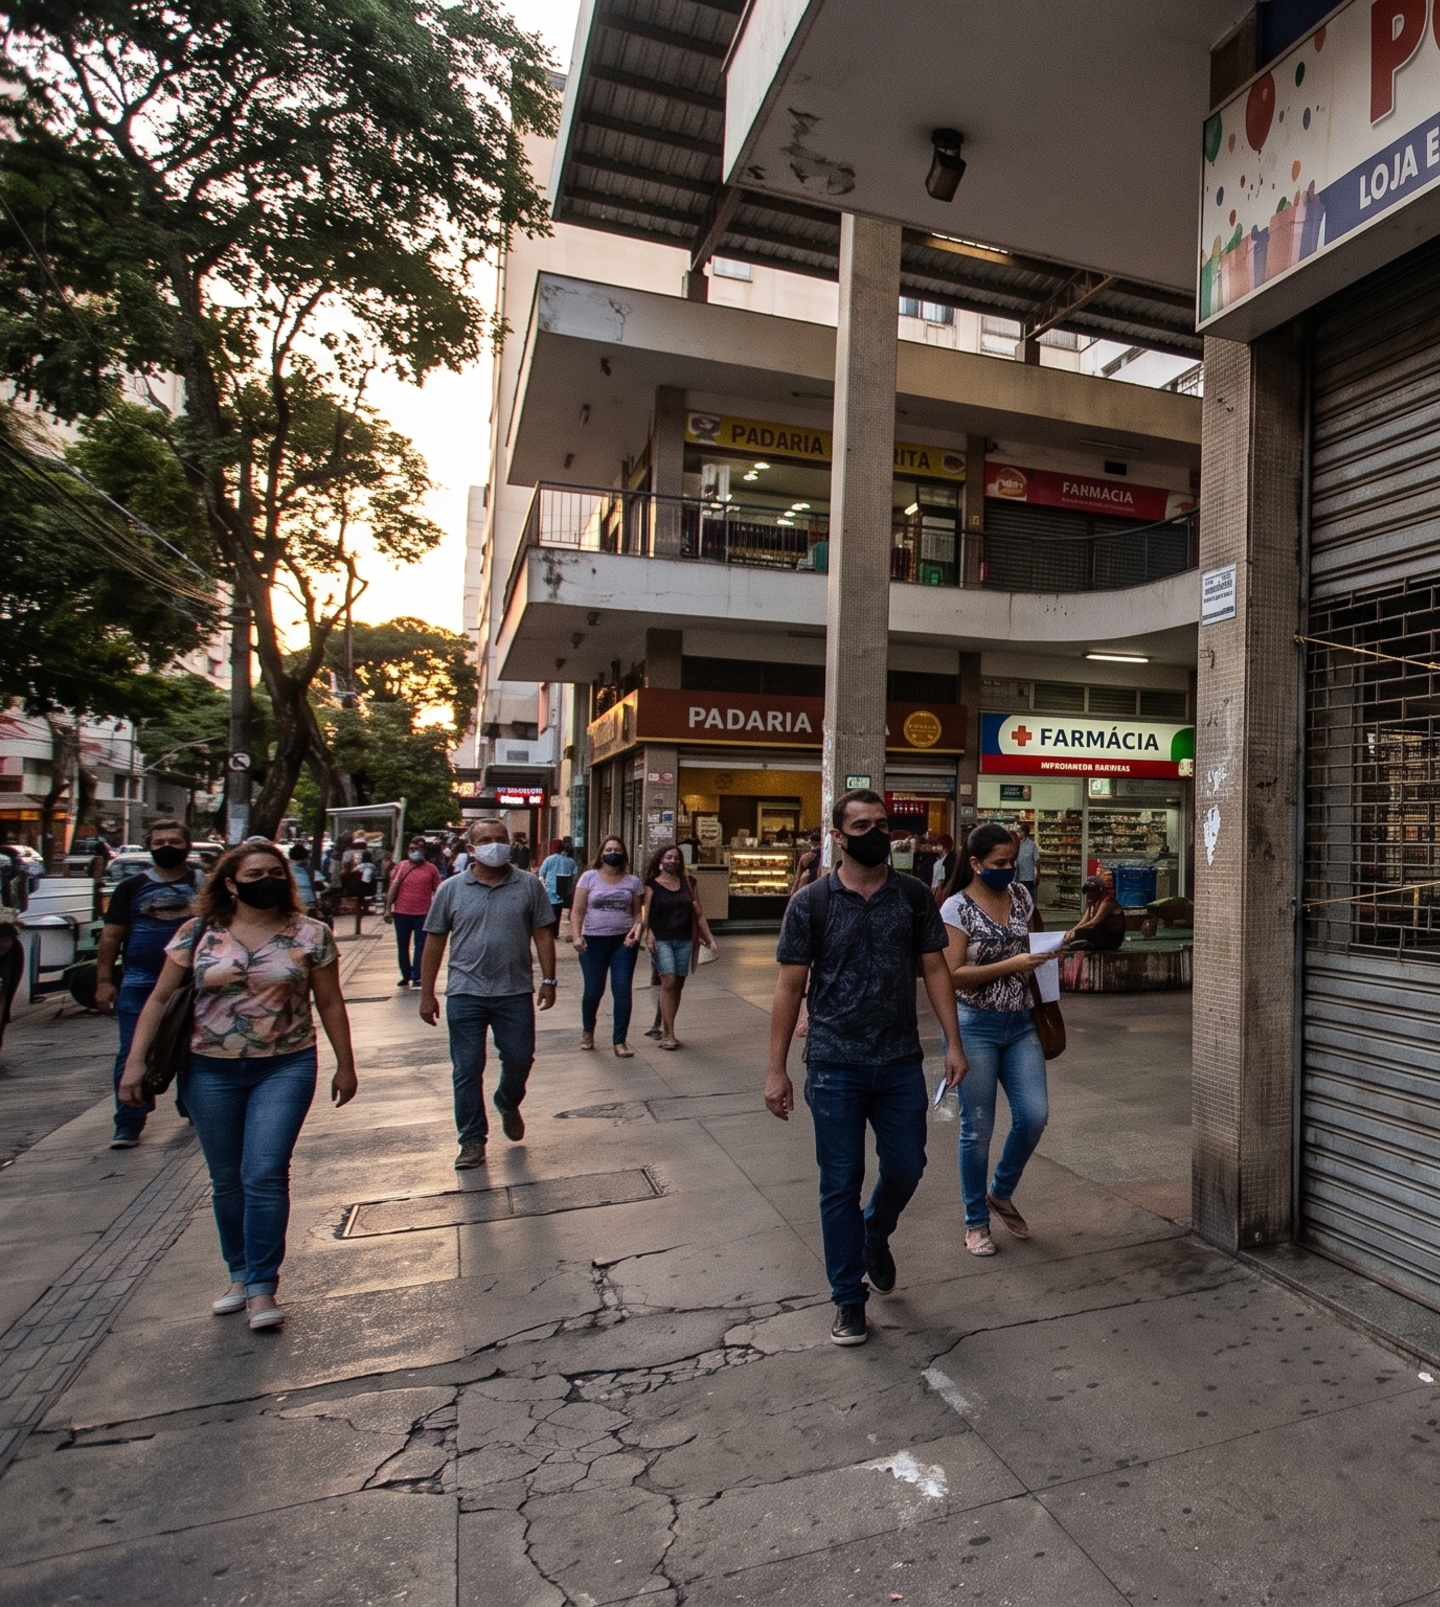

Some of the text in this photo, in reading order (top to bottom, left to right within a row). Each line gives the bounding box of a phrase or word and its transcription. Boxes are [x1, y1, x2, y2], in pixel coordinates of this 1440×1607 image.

[1359, 144, 1419, 210] LOJA
[731, 424, 824, 455] PADARIA
[688, 706, 813, 733] PADARIA
[1040, 725, 1159, 751] FARMÁCIA
